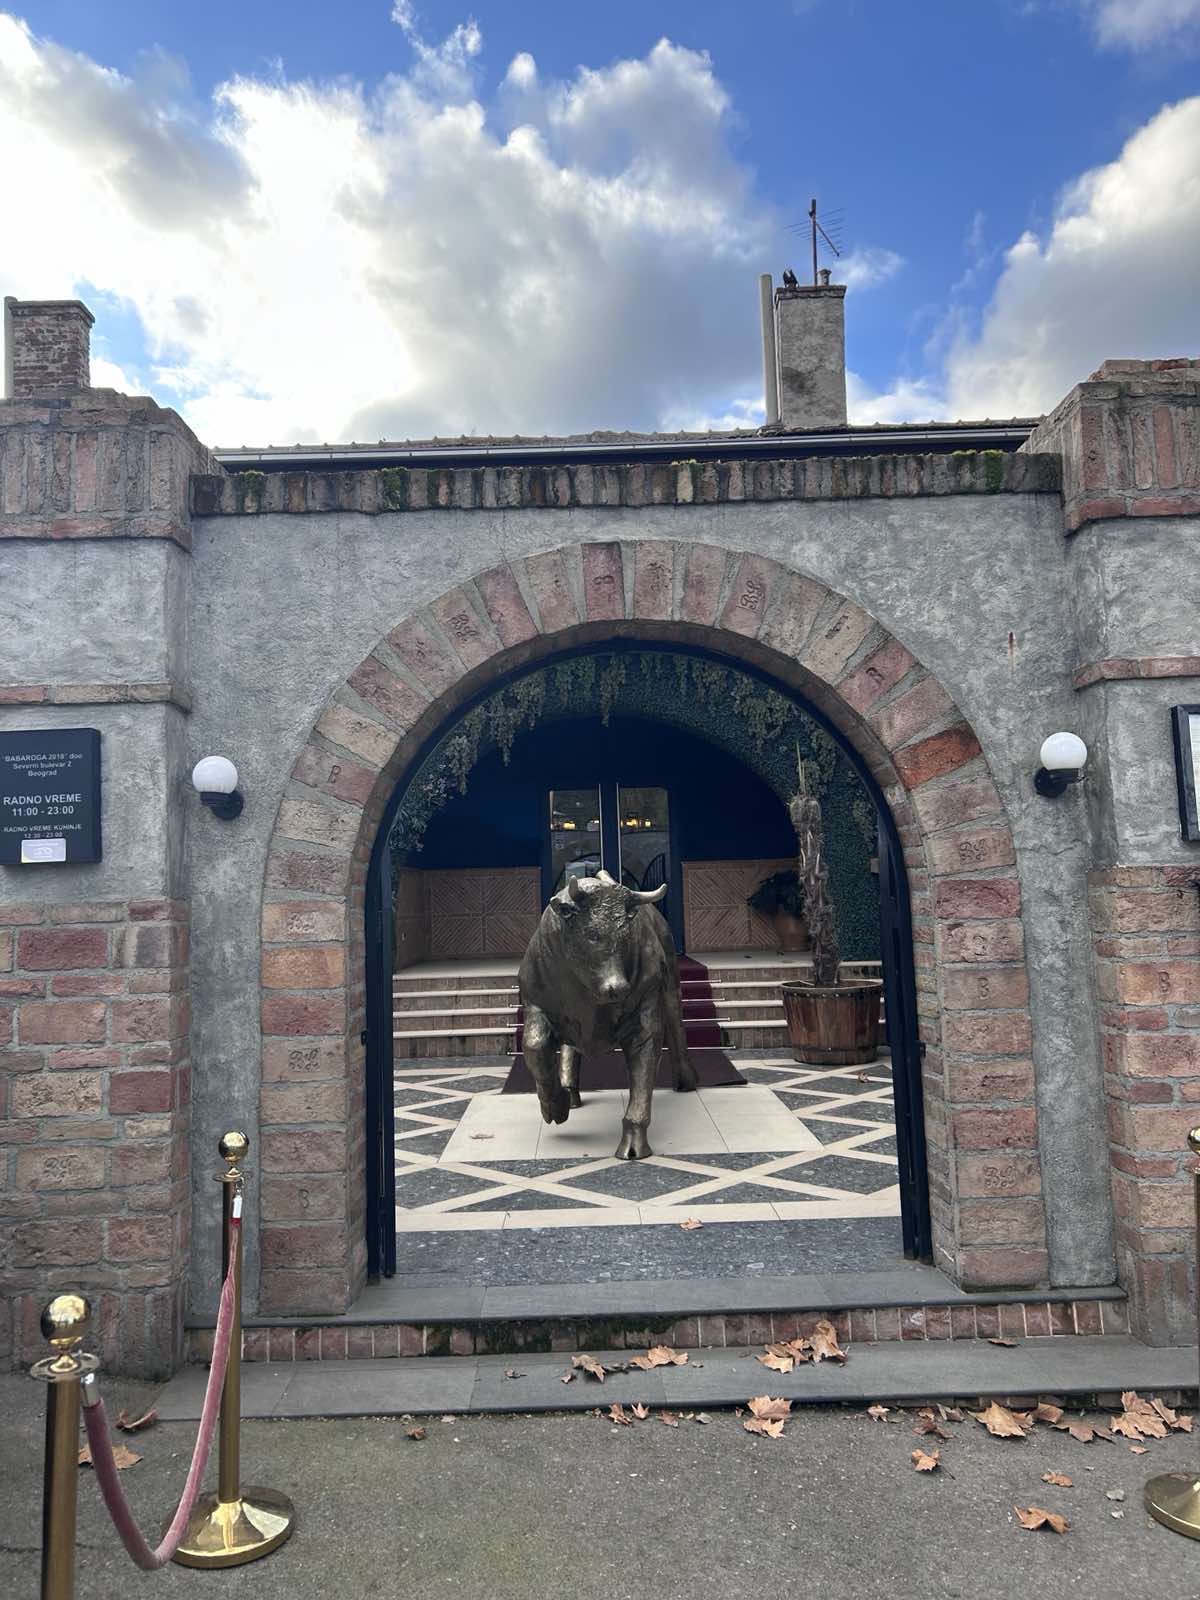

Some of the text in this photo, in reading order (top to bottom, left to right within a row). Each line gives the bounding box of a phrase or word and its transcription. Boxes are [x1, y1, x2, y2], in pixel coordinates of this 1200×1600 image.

[28, 769, 57, 778] Beograd
[3, 793, 82, 805] RADNO VREME
[12, 807, 38, 816] 11:00
[47, 806, 74, 815] 23:00
